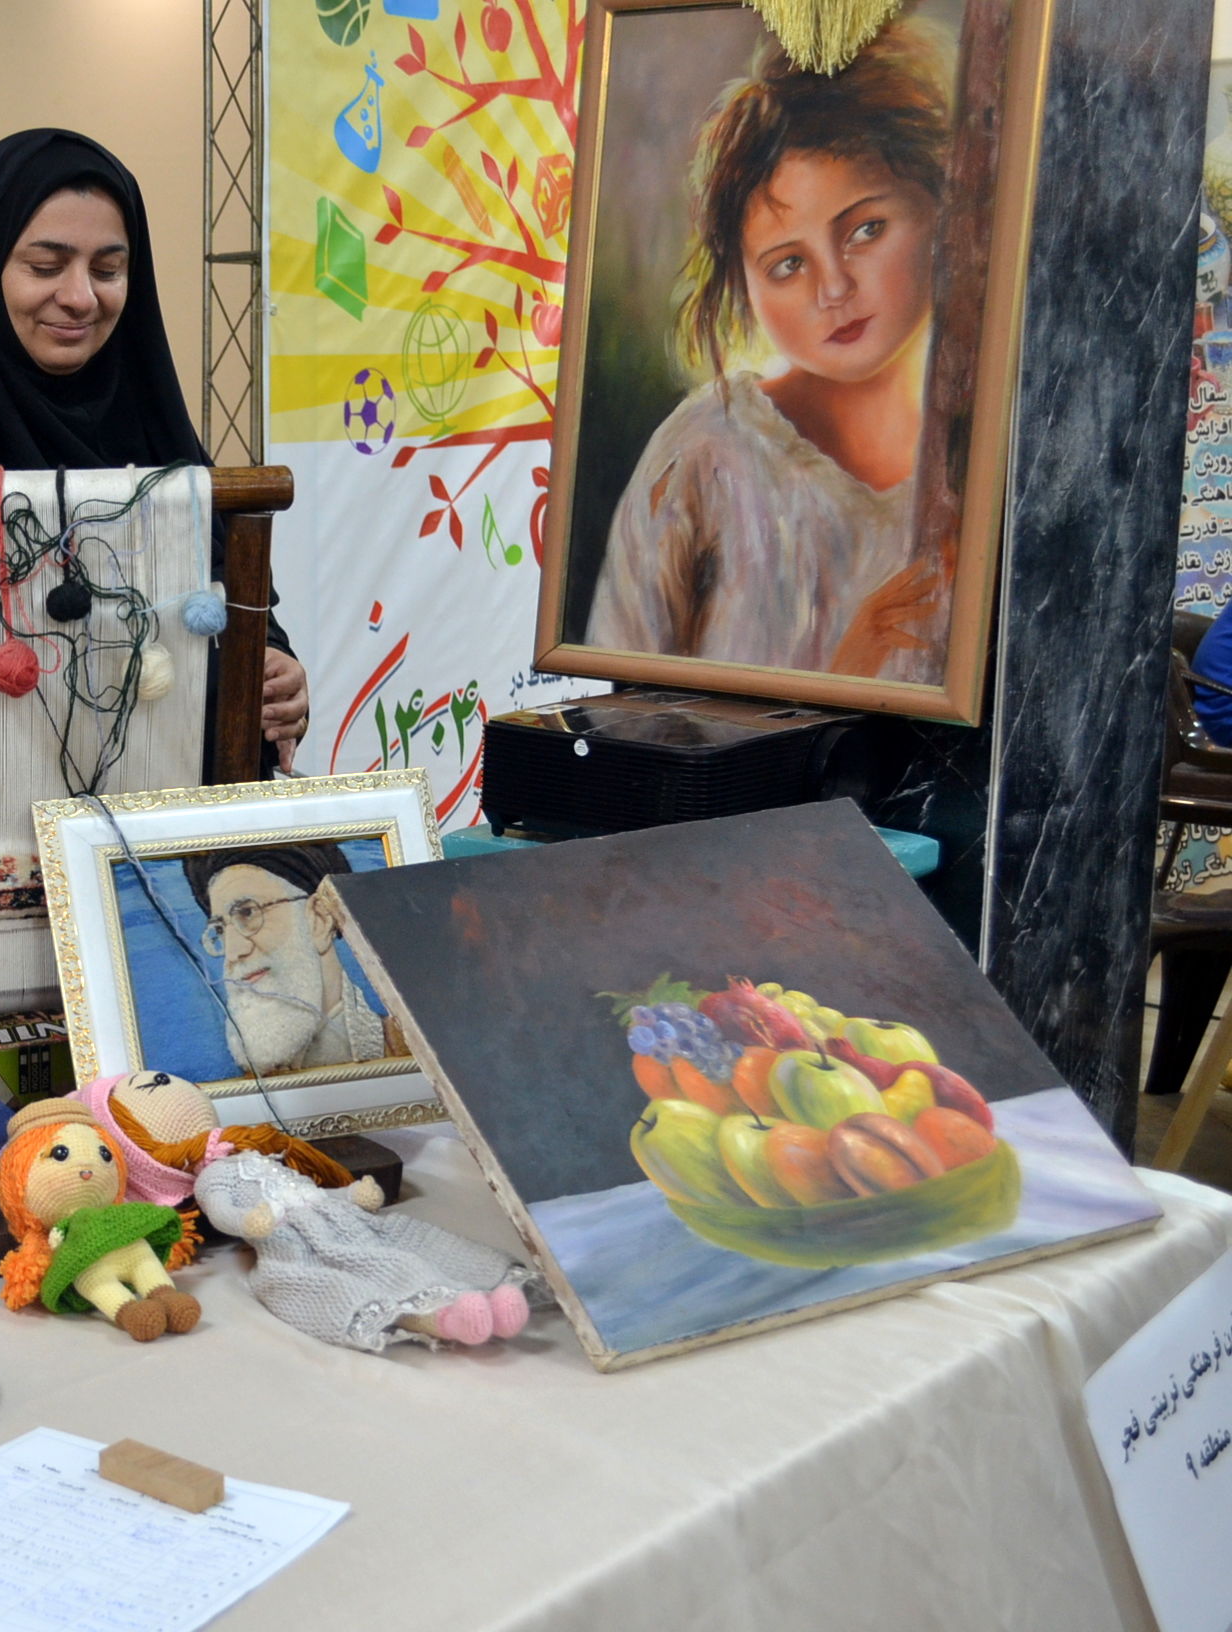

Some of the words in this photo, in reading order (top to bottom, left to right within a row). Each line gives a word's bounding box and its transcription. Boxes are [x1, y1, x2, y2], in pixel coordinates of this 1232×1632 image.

[1190, 386, 1228, 410] سفال
[1187, 418, 1232, 444] افزایش
[1195, 454, 1232, 477] رورش
[1180, 516, 1218, 541] قدرت
[1177, 553, 1201, 571] نقاش
[1175, 585, 1212, 607] نقاشی
[509, 671, 524, 698] در
[1182, 1330, 1222, 1399] فرهنگی
[1144, 1373, 1179, 1437] تربیتی
[1122, 1409, 1140, 1464] فجر
[1200, 1428, 1232, 1468] منطقه
